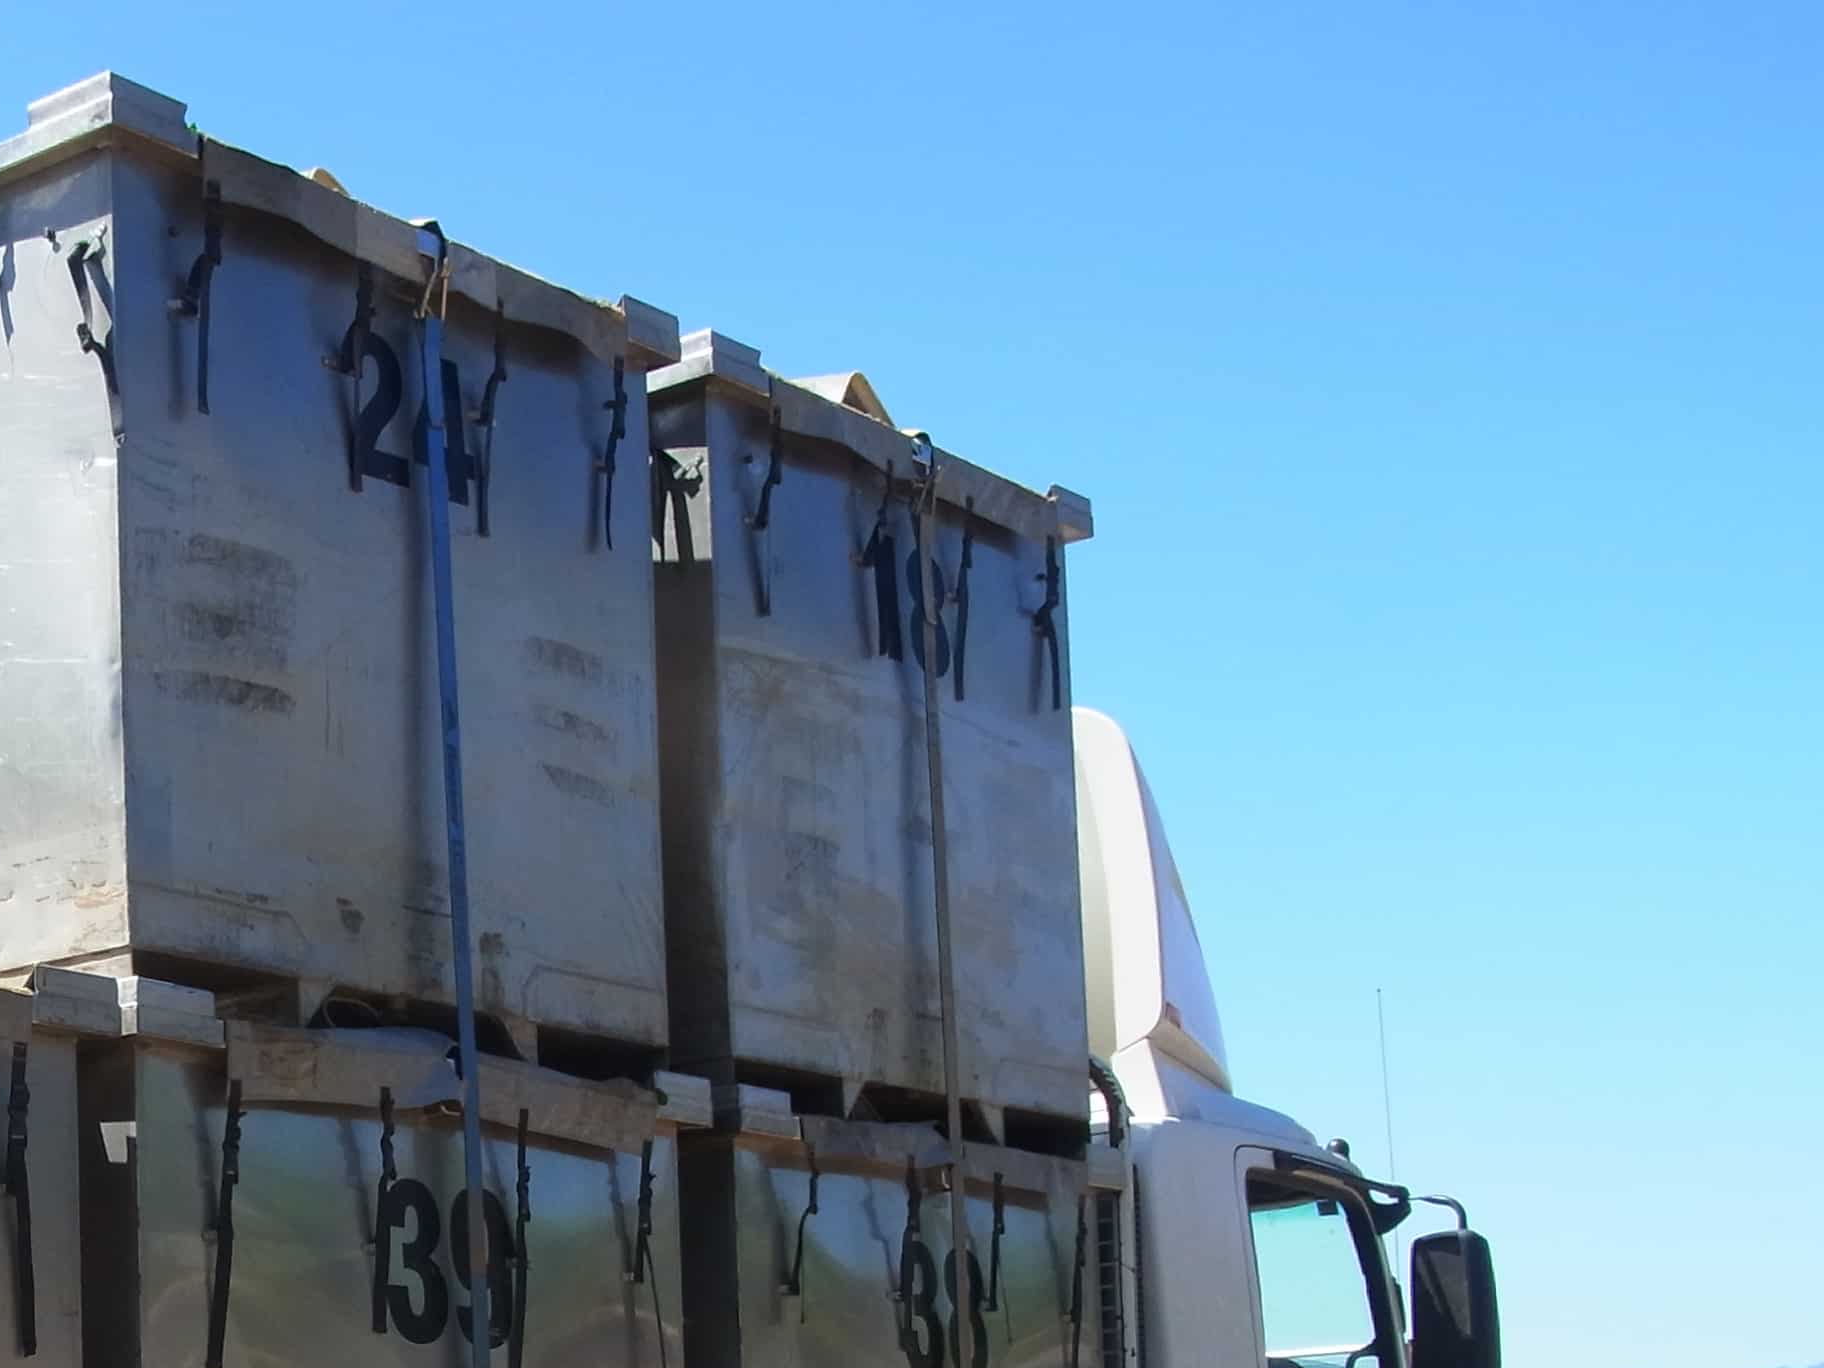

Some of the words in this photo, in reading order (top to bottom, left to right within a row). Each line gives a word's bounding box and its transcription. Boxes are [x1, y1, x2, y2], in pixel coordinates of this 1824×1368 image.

[344, 330, 477, 507] 24
[872, 535, 951, 679] 18
[384, 1178, 516, 1350] 39
